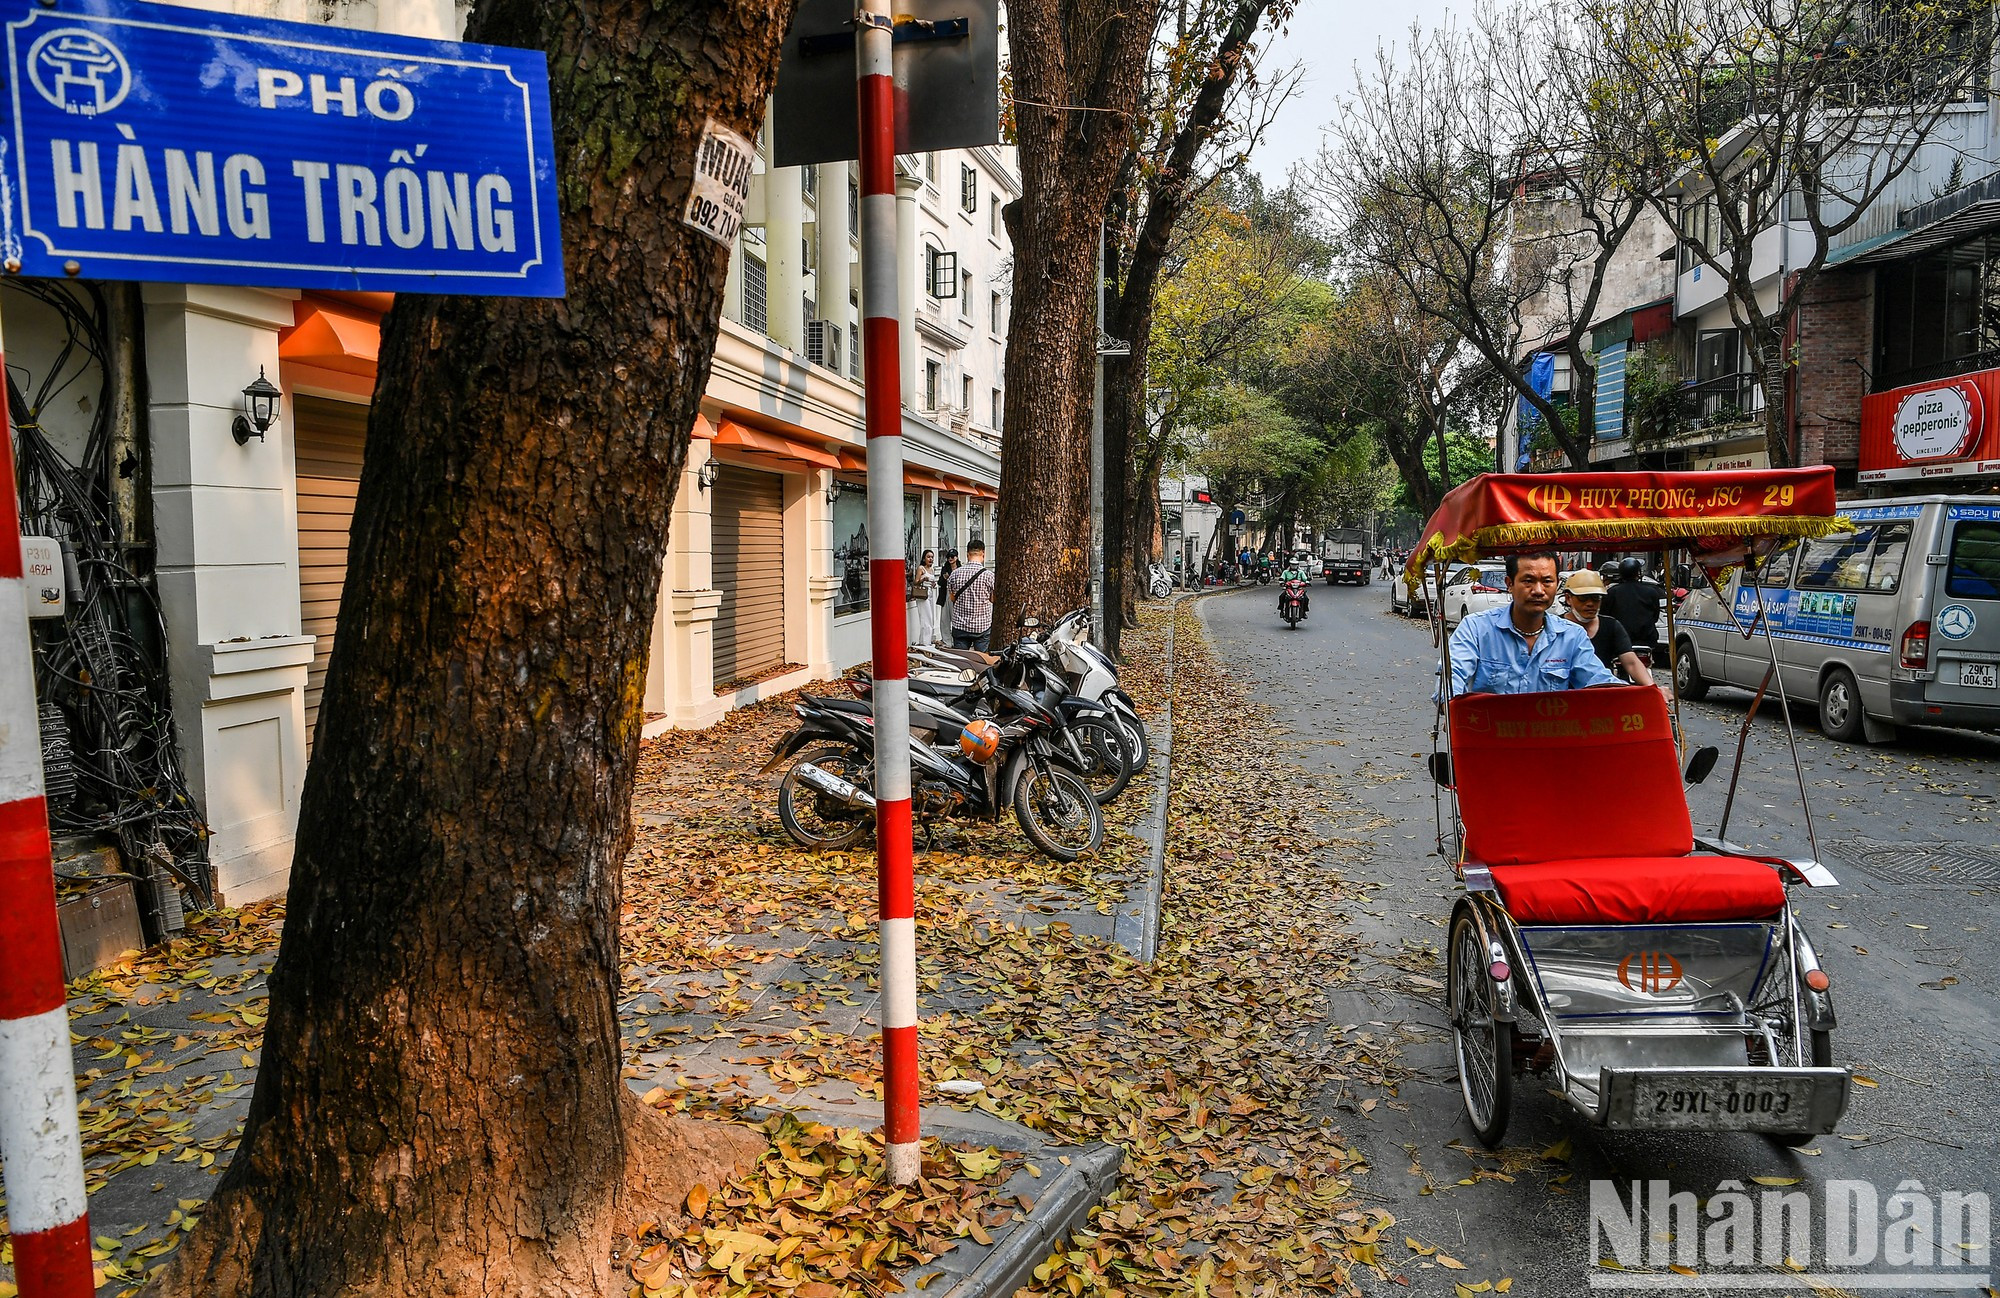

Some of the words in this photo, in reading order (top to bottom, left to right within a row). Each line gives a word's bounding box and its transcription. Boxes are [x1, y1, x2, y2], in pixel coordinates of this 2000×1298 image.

[257, 65, 420, 122] PHỐ
[50, 123, 272, 240] HÀNG
[292, 143, 517, 253] TRỐNG
[690, 195, 720, 231] 092
[1918, 400, 1943, 420] pizza
[1902, 413, 1958, 439] pepperonis
[1579, 488, 1622, 509] HUY
[1762, 484, 1795, 507] 29
[1960, 509, 1989, 518] sapy
[29, 564, 52, 576] 462H
[1963, 674, 1994, 687] 004.95
[1968, 664, 1991, 676] 29KT
[1621, 713, 1644, 732] 29
[1656, 1091, 1791, 1114] 29XL-0003
